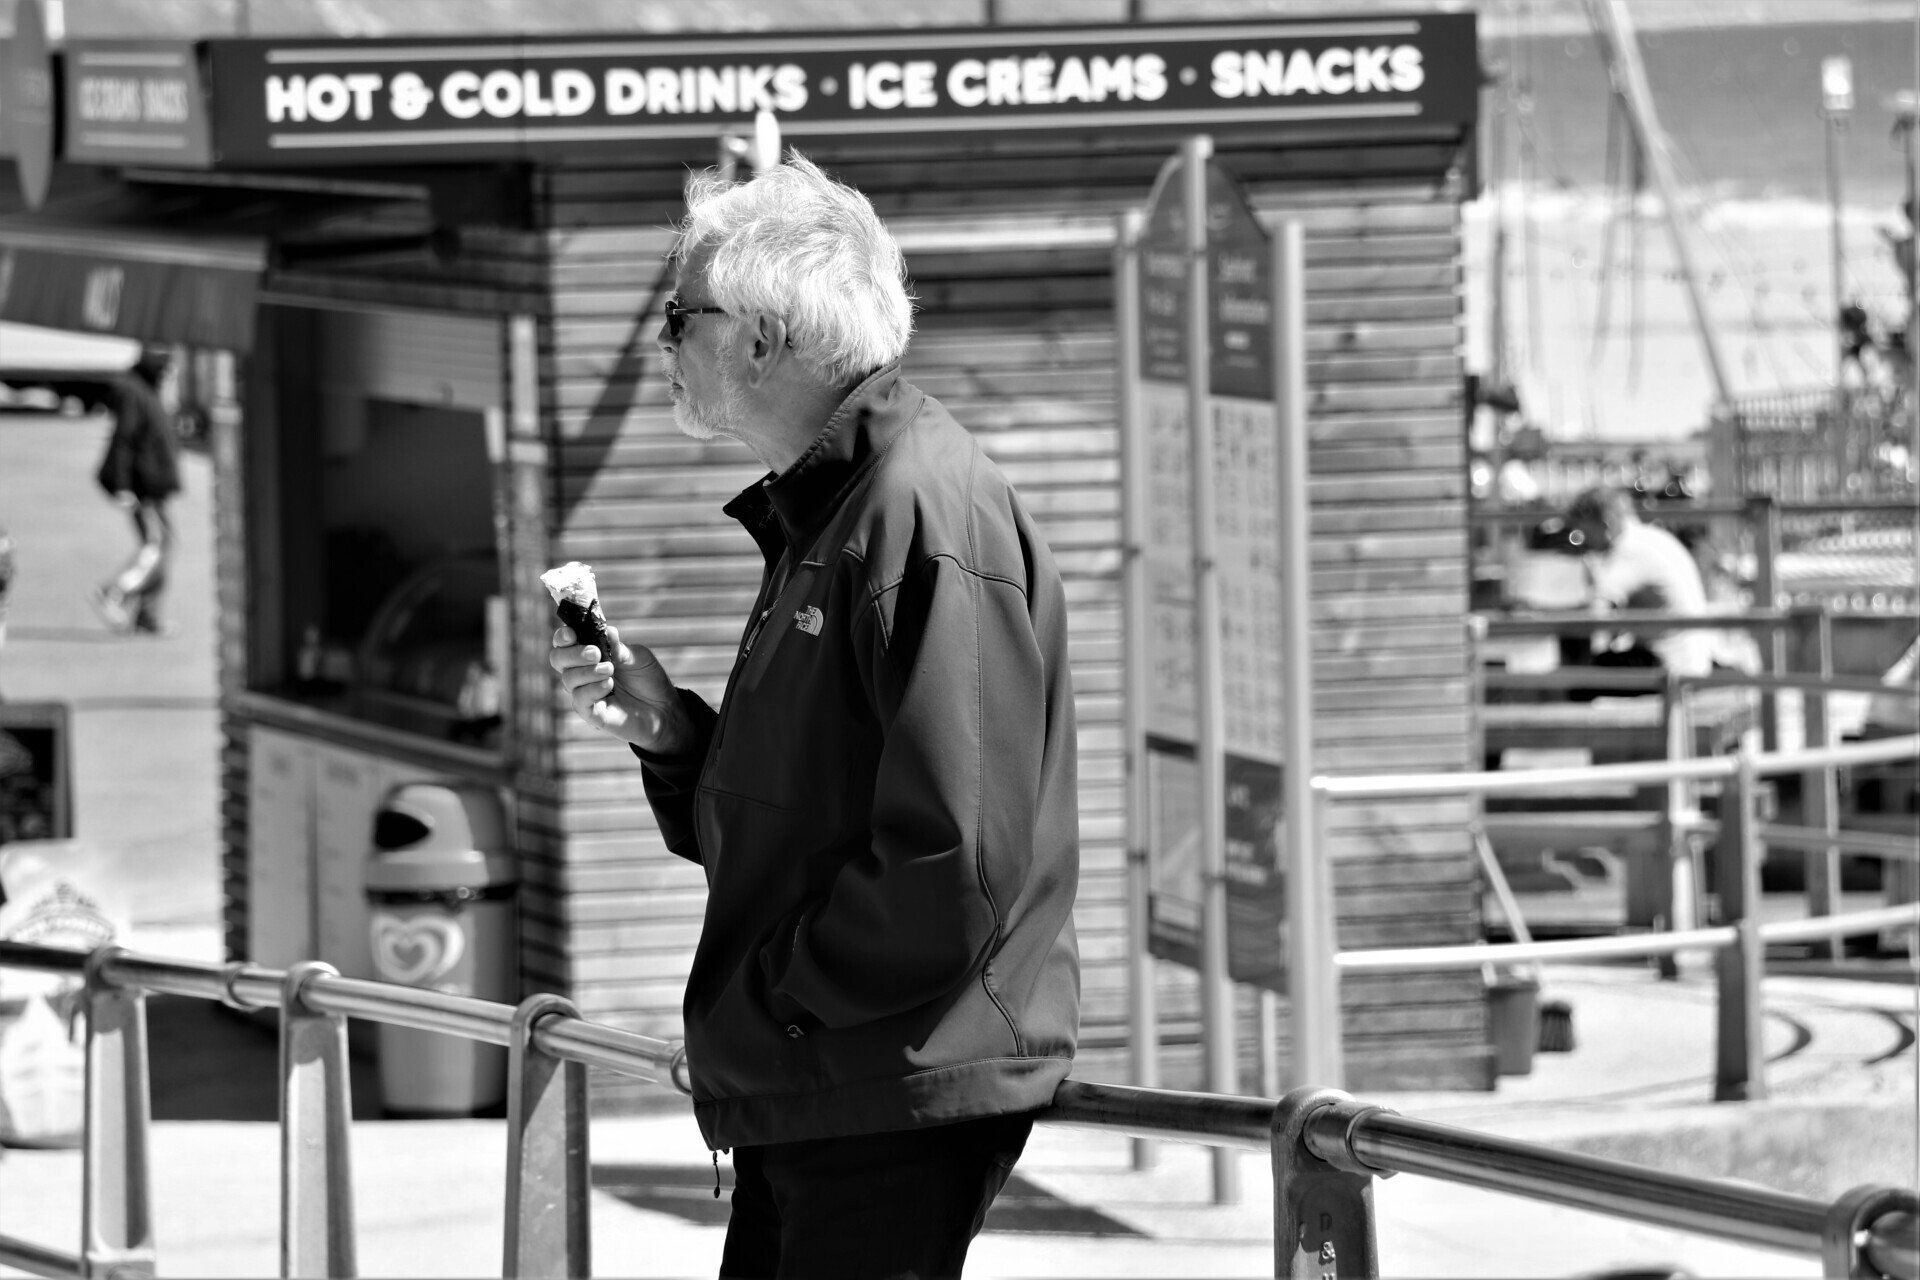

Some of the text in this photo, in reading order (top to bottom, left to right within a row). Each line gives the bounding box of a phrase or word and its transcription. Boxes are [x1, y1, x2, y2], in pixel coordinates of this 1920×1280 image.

[265, 45, 1425, 123] HOT & COLD DRINKS ICE CREAMS SNACKS
[1321, 1240, 1336, 1260] &
